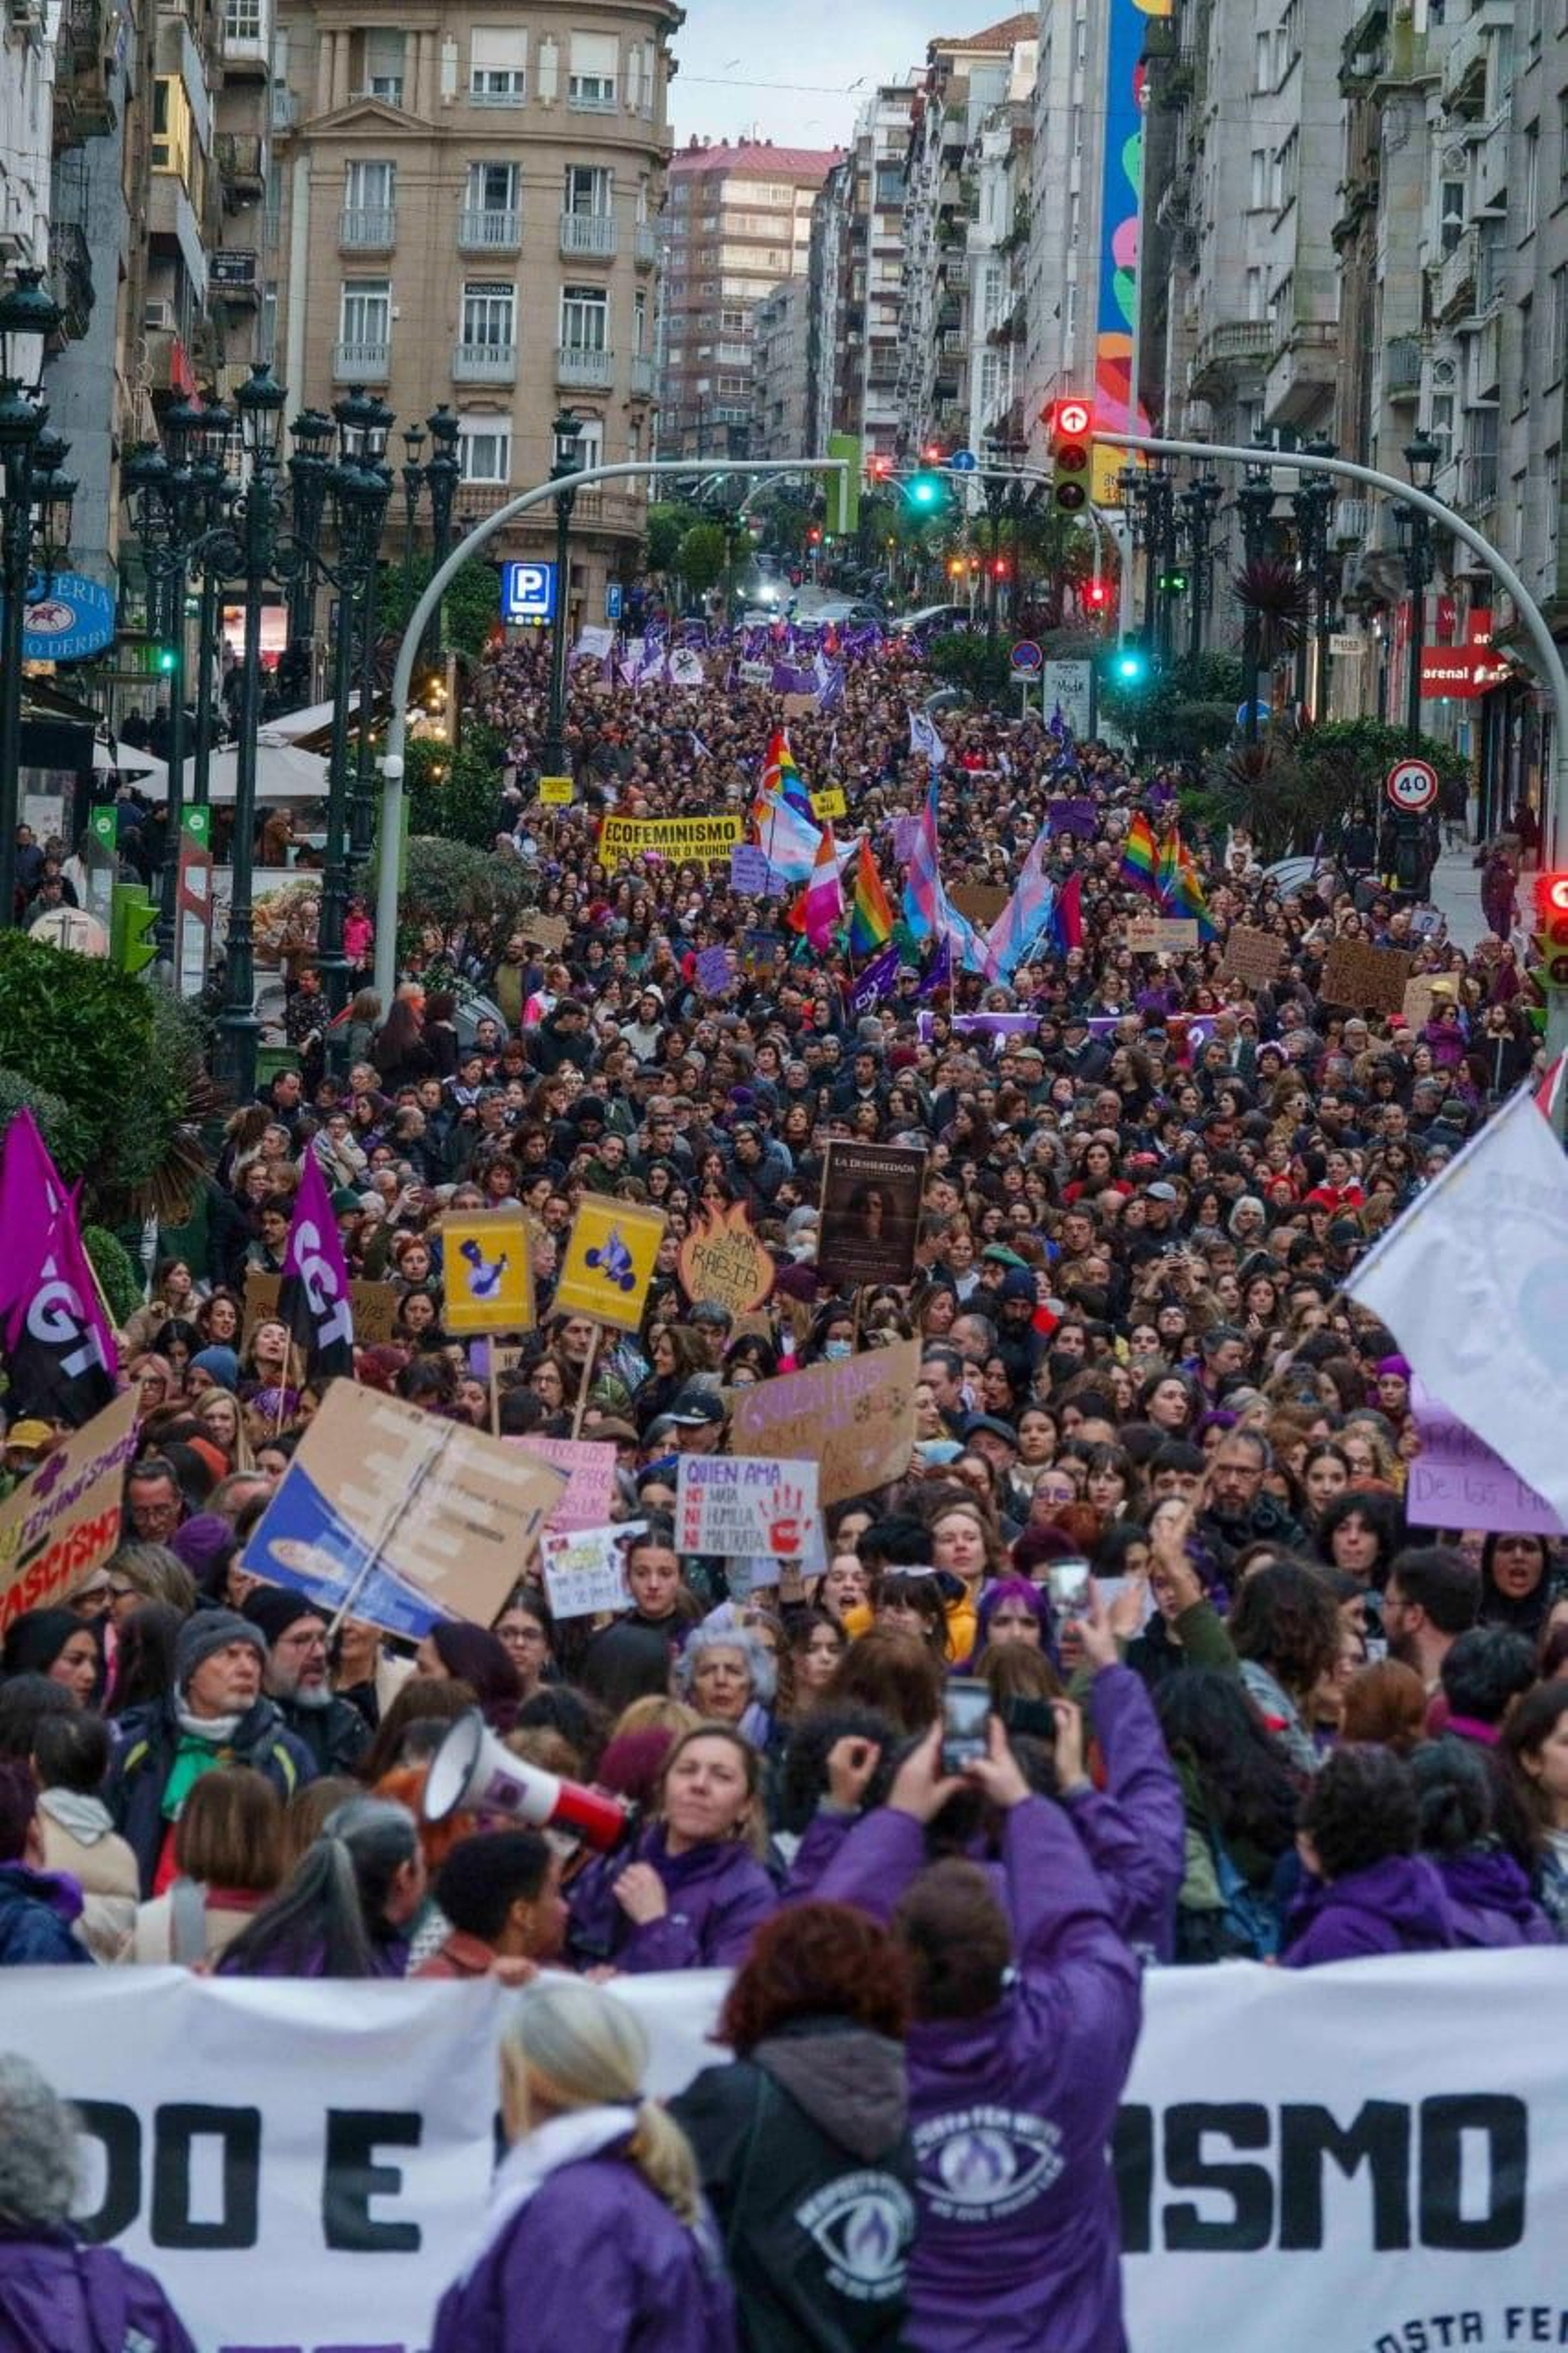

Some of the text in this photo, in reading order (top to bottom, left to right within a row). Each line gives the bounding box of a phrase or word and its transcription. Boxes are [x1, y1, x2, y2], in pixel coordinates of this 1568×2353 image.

[57, 576, 110, 613] ERIA
[517, 569, 542, 600] P
[50, 630, 109, 655] DERBY
[1423, 667, 1469, 679] arenal
[1399, 775, 1427, 792] 40
[605, 822, 736, 844] ECOFEMINISMO
[691, 1244, 759, 1293] RABIA
[687, 1460, 781, 1486] QUIEN AMA
[59, 2094, 1527, 2254] DO E ISMO
